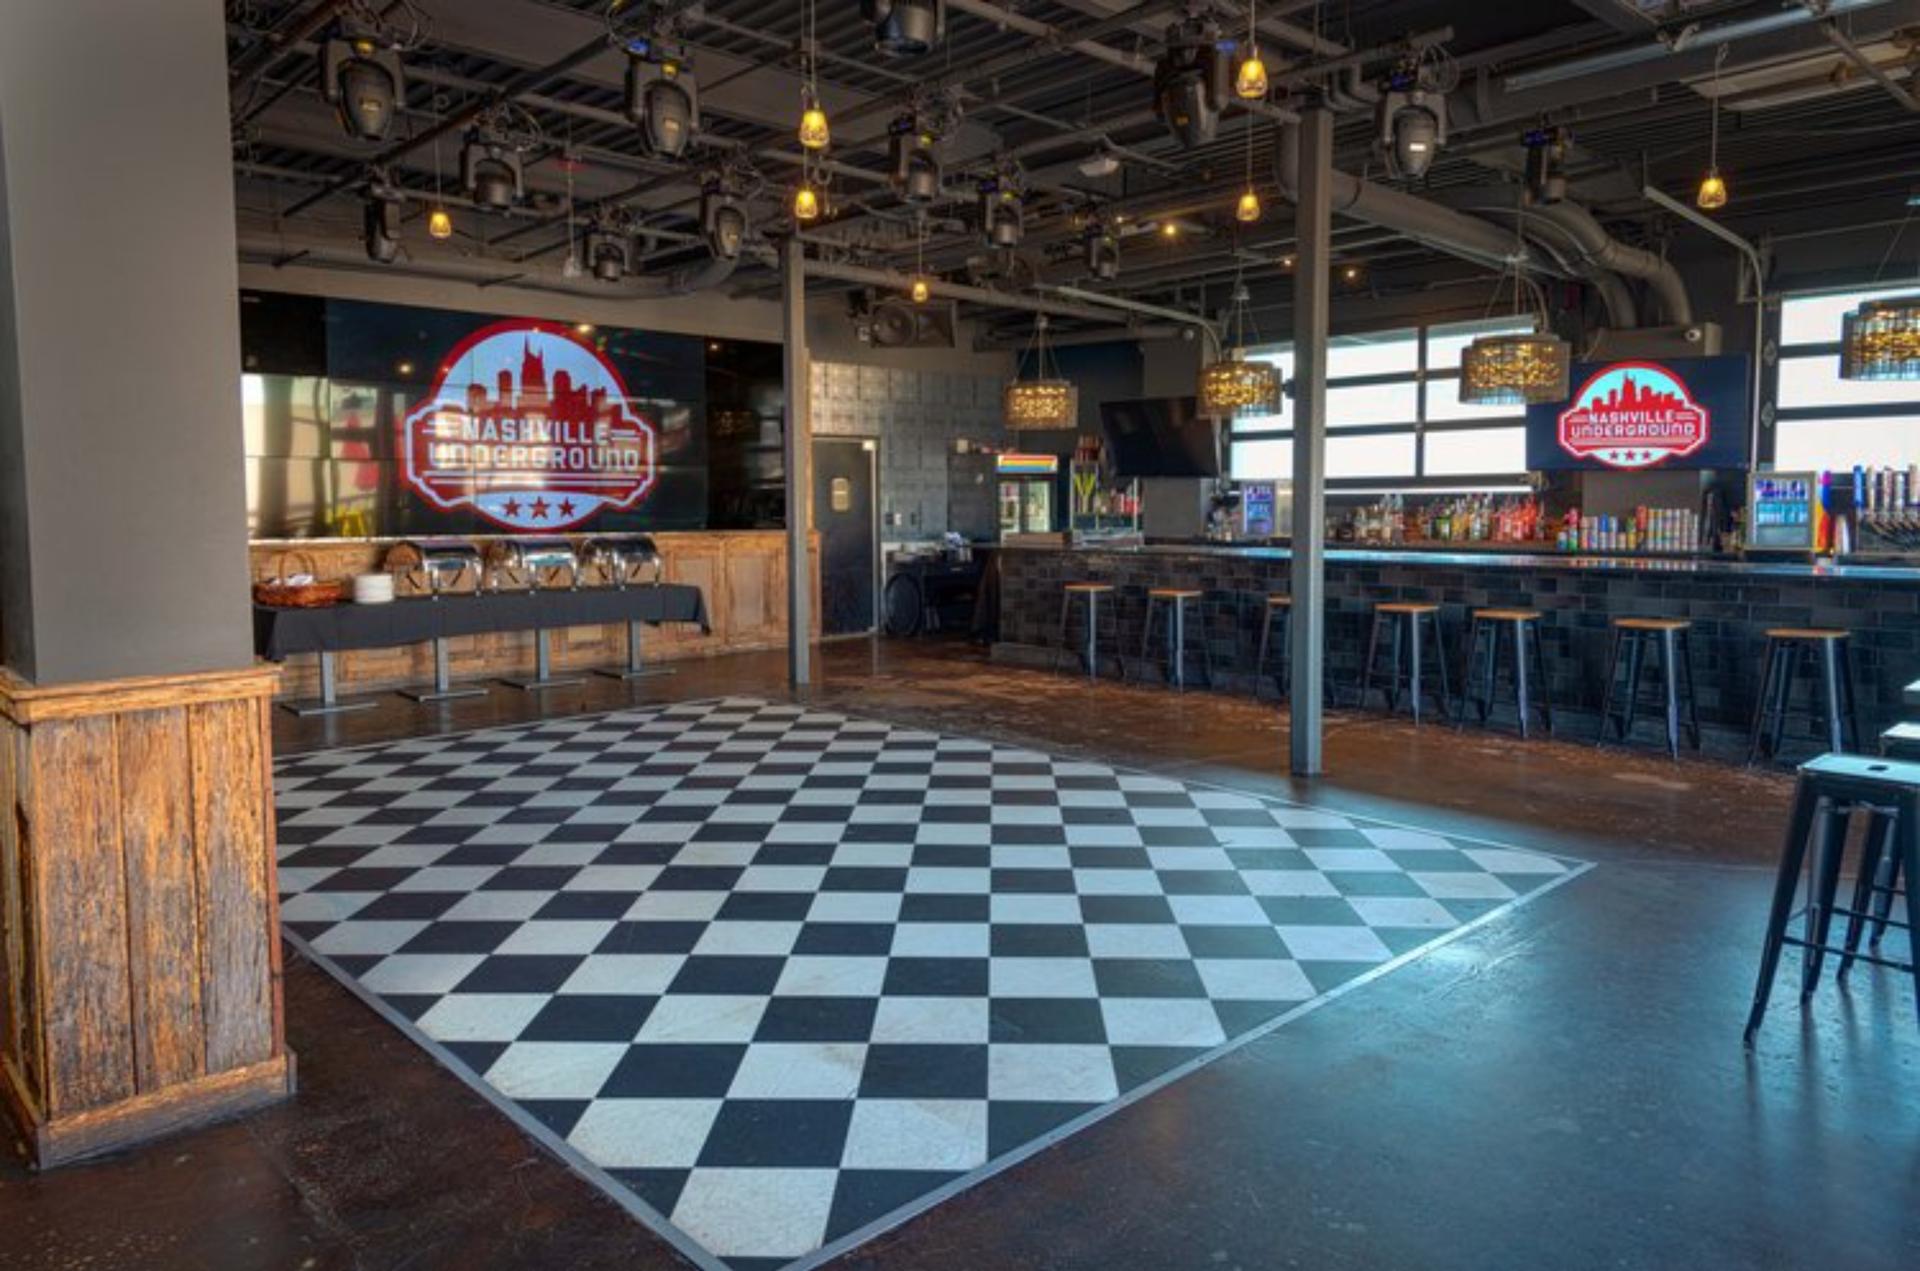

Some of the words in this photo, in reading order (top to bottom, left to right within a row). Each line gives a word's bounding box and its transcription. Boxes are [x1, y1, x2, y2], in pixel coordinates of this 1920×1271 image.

[1589, 410, 1675, 423] NASHVILLE
[461, 417, 610, 444] NASHVILLE
[1571, 423, 1695, 437] UNDERGROUND
[429, 443, 640, 470] UNDERGROUND
